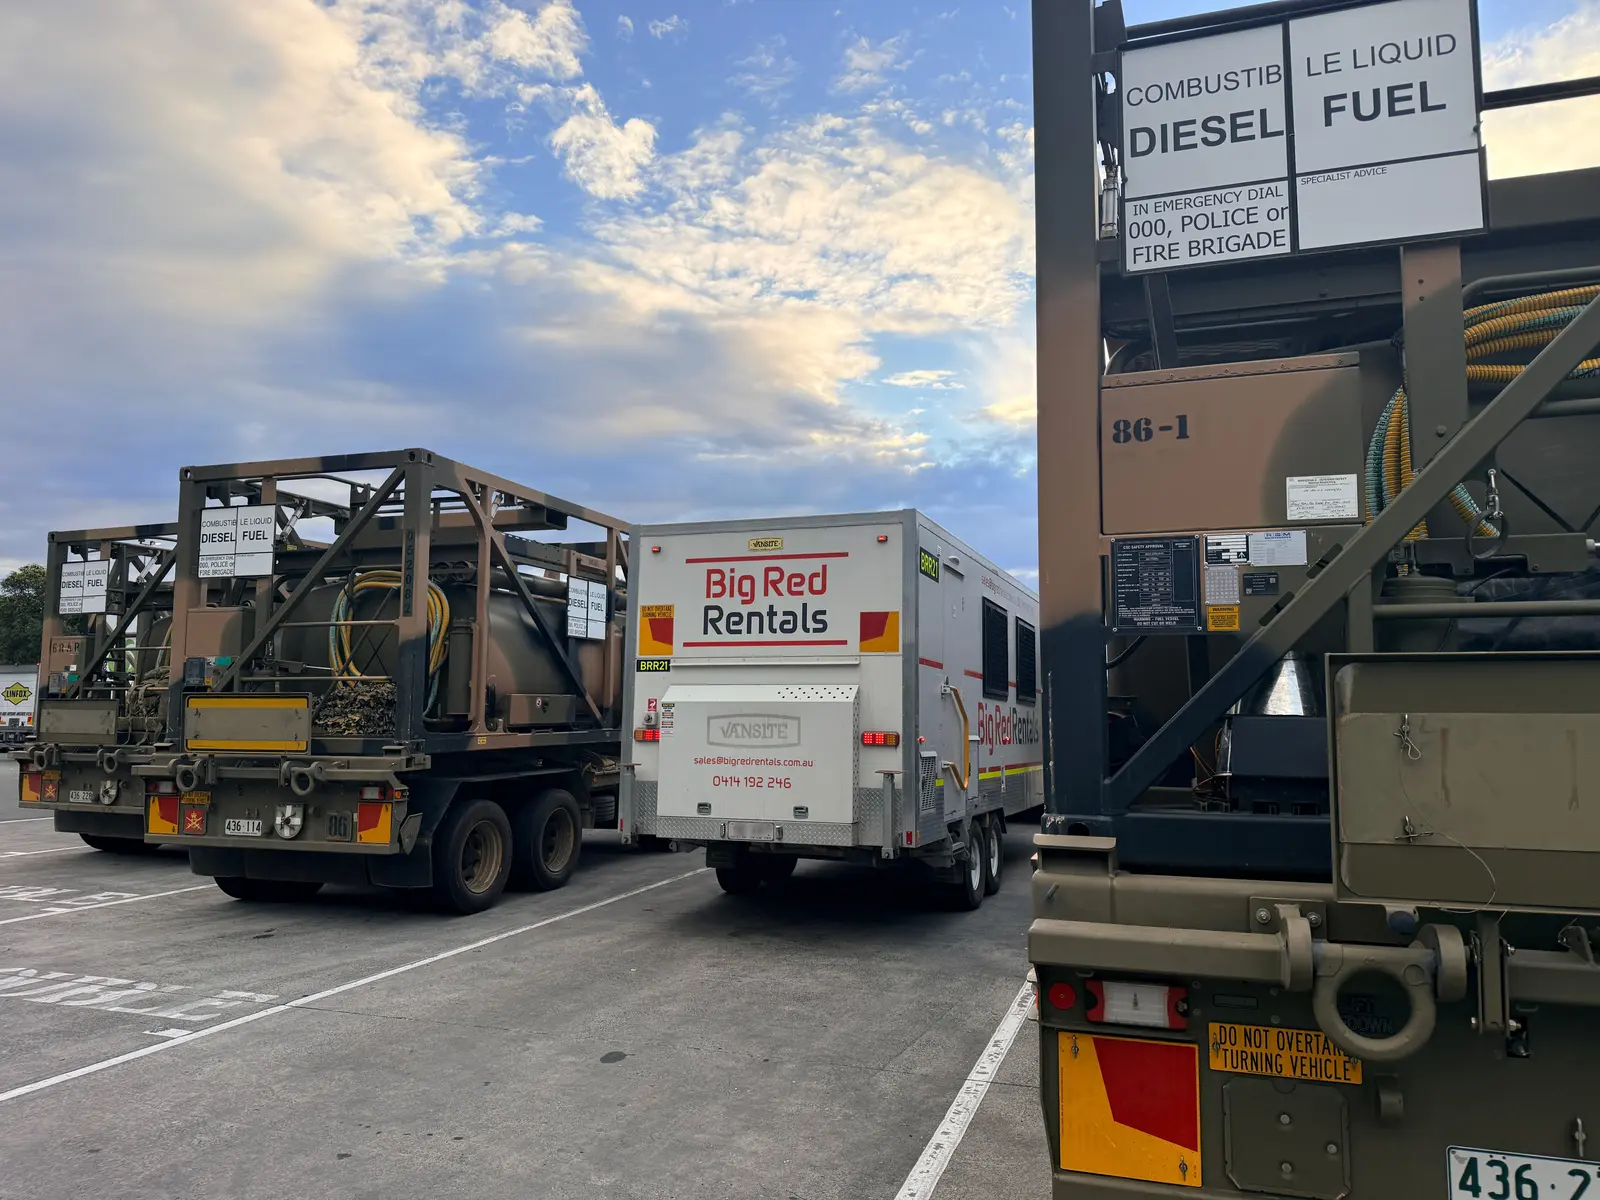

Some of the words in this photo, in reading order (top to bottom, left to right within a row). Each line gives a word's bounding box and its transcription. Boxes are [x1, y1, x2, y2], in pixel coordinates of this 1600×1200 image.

[1306, 52, 1342, 77] LE
[1353, 33, 1456, 70] LIQUID
[1126, 64, 1282, 107] COMBUSTIB
[1323, 80, 1446, 127] FUEL
[1129, 108, 1284, 158] DIESEL
[1300, 171, 1351, 186] SPECIALIST
[1353, 166, 1388, 179] ADVICE
[1132, 203, 1149, 216] IN
[1154, 190, 1242, 214] EMERGENCY
[1248, 186, 1283, 201] DIAL
[1128, 218, 1173, 240] 000,
[1181, 206, 1258, 233] POLICE
[1266, 205, 1289, 222] or
[1132, 242, 1180, 264] FIRE
[1188, 229, 1286, 258] BRIGADE
[1112, 414, 1190, 443] 86-1
[250, 517, 272, 525] LIQUID
[201, 532, 236, 543] DIESEL
[242, 530, 268, 541] FUEL
[752, 540, 779, 548] VANSITE
[921, 551, 938, 579] BRR21
[61, 580, 83, 588] DIESEL
[87, 579, 104, 587] FUEL
[706, 567, 755, 605] Big
[763, 564, 828, 597] Red
[568, 598, 587, 608] DIESEL
[591, 602, 603, 612] FUEL
[703, 602, 828, 635] Rentals
[640, 661, 668, 670] BRR21
[6, 690, 27, 698] LINFOX
[719, 721, 788, 739] VANSITE
[978, 702, 994, 756] Big
[995, 706, 1011, 745] Red
[1012, 708, 1039, 745] Rentals
[693, 756, 814, 767] sales@bigredrentals.com.au
[712, 775, 740, 787] 0414
[744, 776, 764, 788] 192
[767, 777, 792, 789] 246
[1219, 1025, 1237, 1046] DO
[1244, 1027, 1269, 1050] NOT
[1222, 1048, 1283, 1074] TURNING
[1290, 1055, 1352, 1081] VEHICLE
